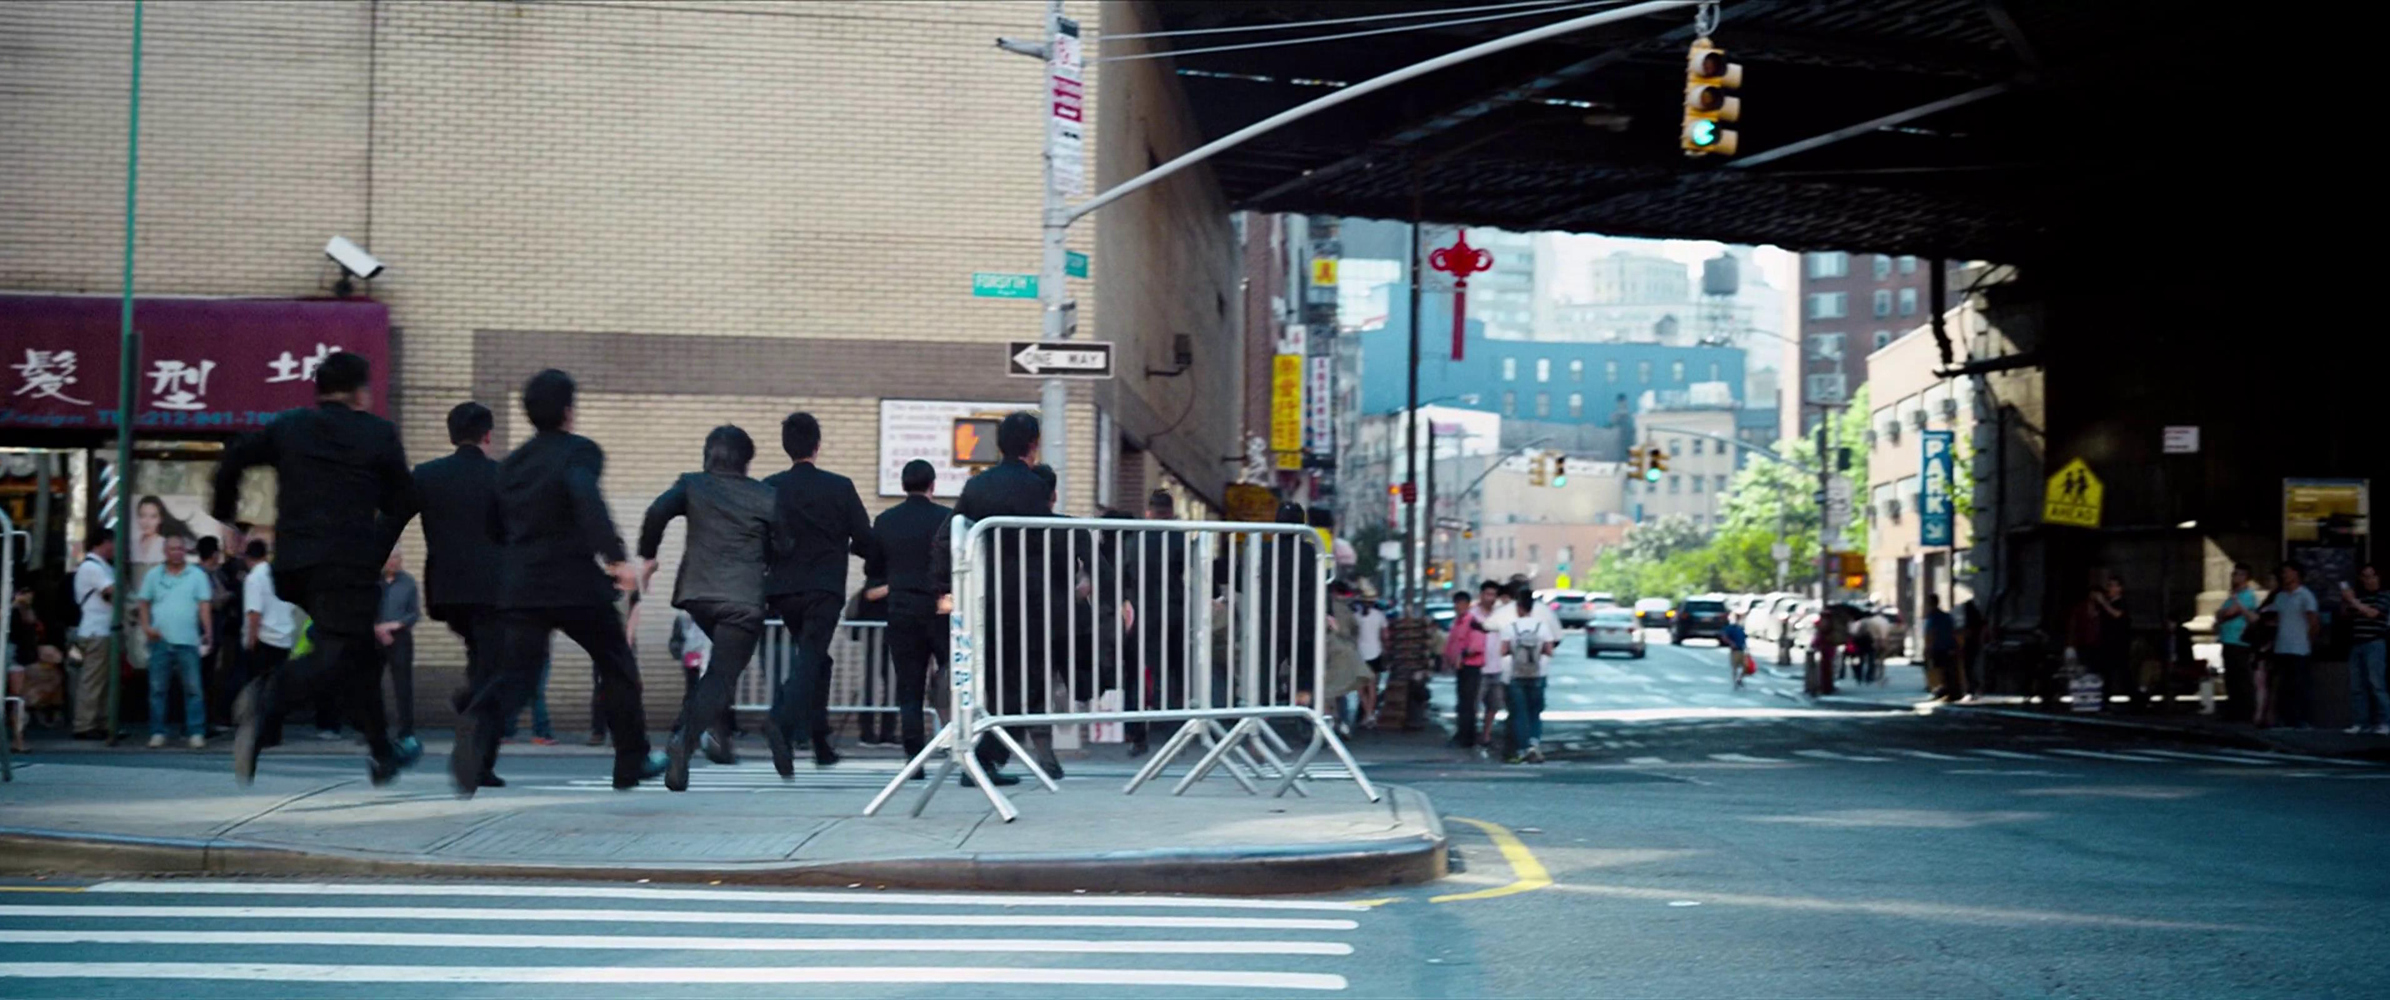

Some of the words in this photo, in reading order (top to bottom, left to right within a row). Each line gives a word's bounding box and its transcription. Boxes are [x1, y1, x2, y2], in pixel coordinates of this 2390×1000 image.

[976, 274, 1028, 290] FORSYTH
[1024, 352, 1052, 365] ONE
[1068, 353, 1098, 364] WAY
[1925, 440, 1946, 514] PARK
[2051, 505, 2092, 521] AHEAD
